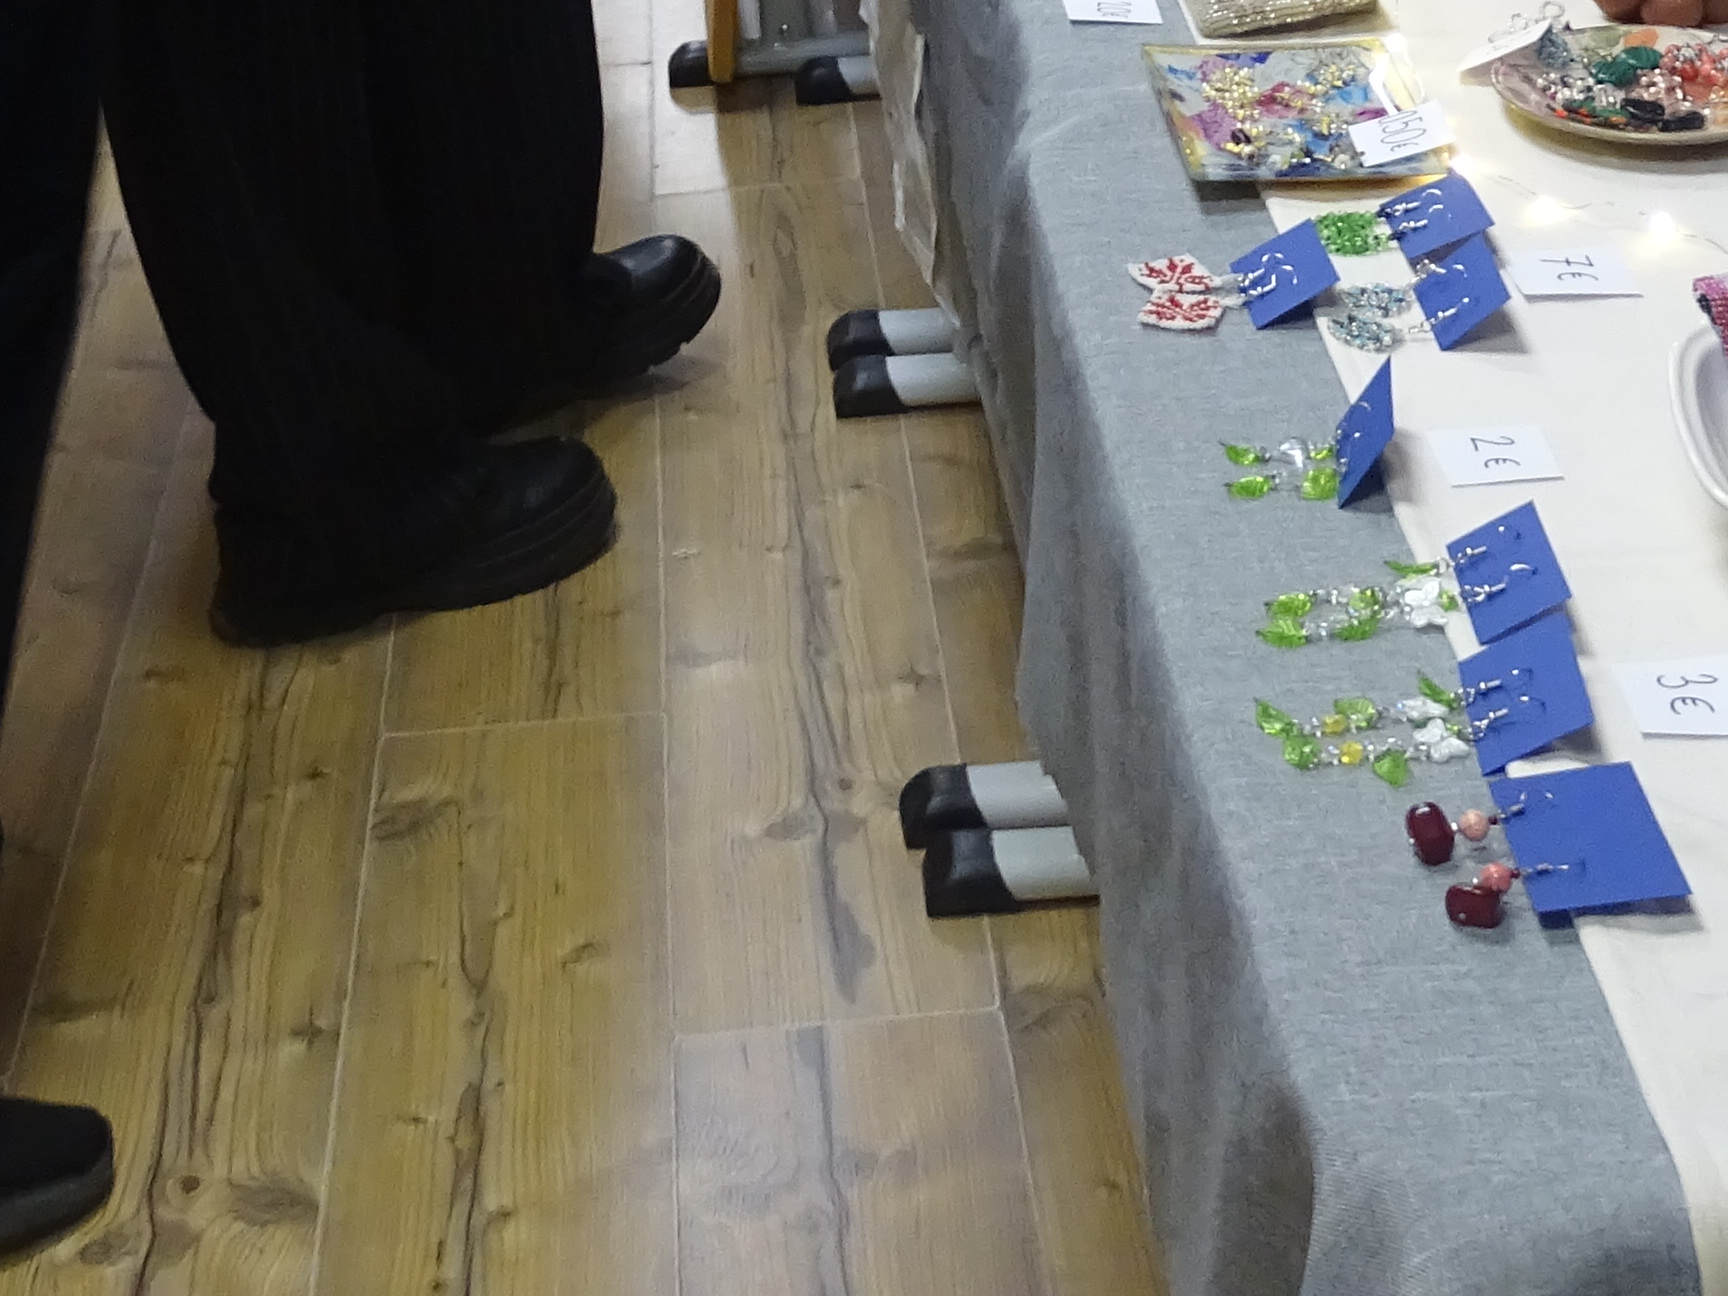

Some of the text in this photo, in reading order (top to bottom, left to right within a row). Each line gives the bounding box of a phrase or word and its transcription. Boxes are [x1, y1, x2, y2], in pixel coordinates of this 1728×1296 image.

[1538, 254, 1599, 281] 7€
[1470, 435, 1521, 469] 2€
[1656, 673, 1719, 716] 3€
